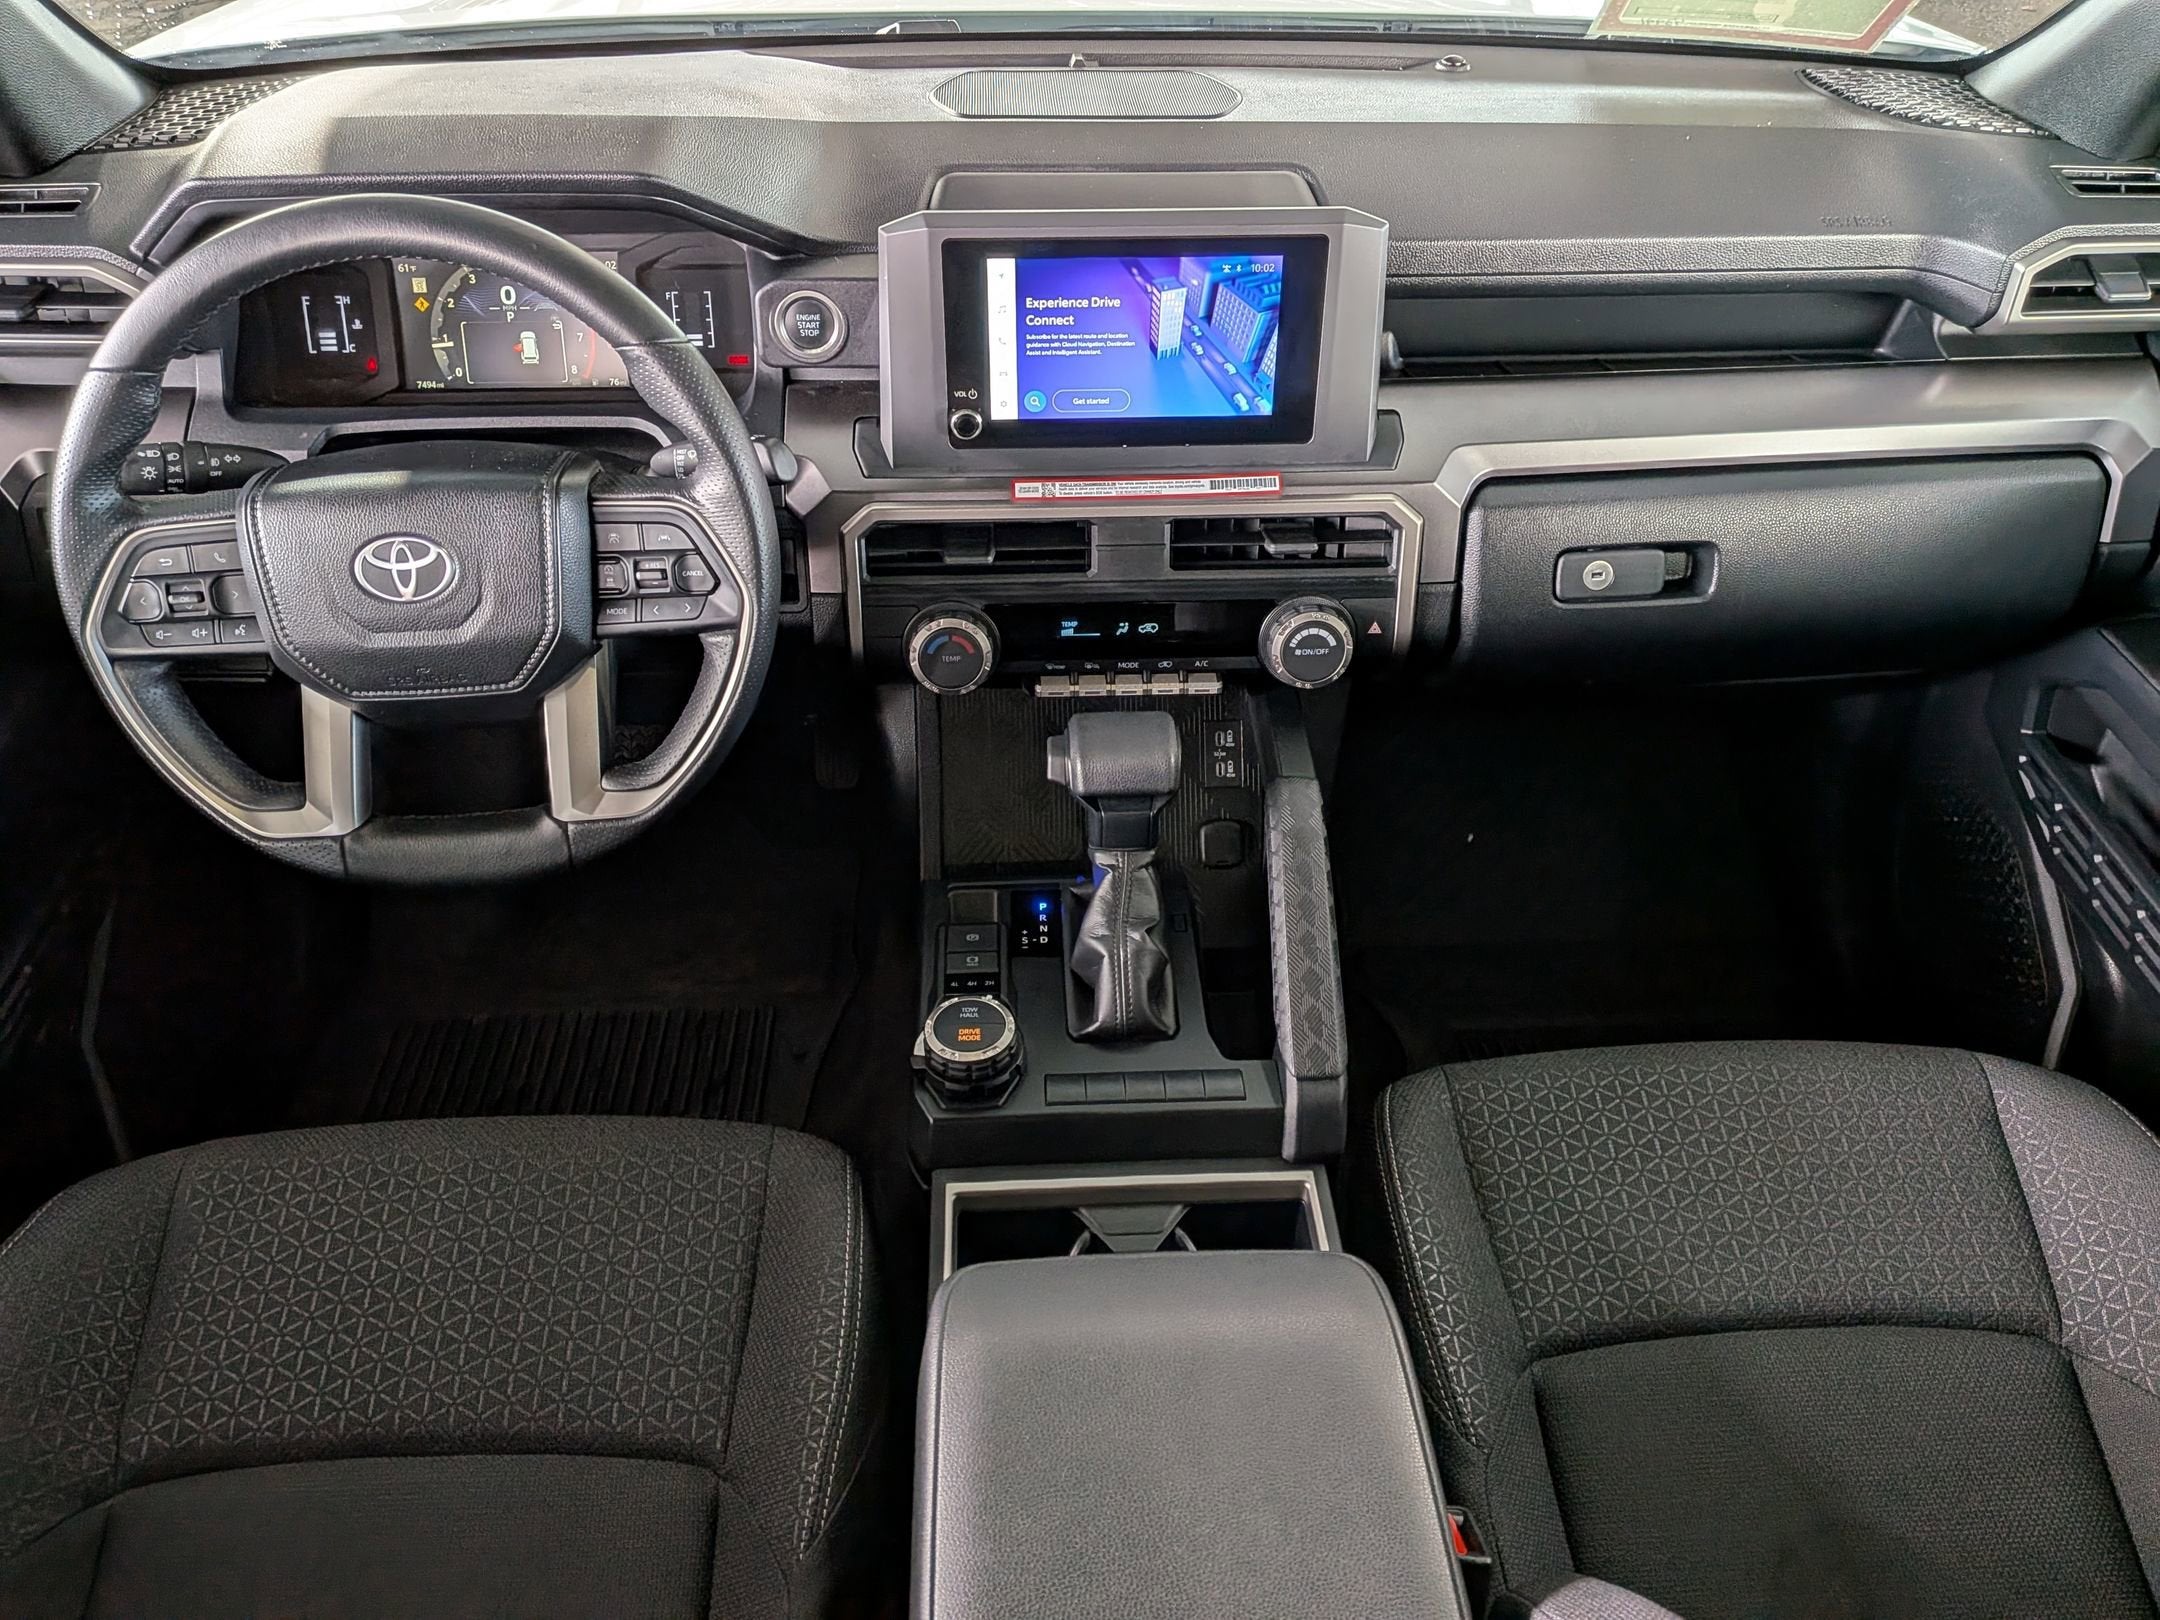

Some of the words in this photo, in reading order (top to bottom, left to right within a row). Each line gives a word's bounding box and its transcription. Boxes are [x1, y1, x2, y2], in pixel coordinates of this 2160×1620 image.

[1251, 263, 1275, 273] 10:02
[468, 273, 476, 284] 3
[500, 285, 516, 305] 0
[447, 297, 455, 308] 2
[1025, 296, 1089, 311] Experience
[1091, 296, 1121, 308] Drive
[506, 311, 514, 323] P
[796, 313, 821, 321] ENGINE
[1025, 315, 1075, 326] Connect
[797, 321, 820, 329] START
[576, 332, 584, 342] 7
[800, 329, 820, 337] STOP
[455, 367, 463, 377] 0
[570, 365, 578, 375] 8
[953, 390, 967, 398] VOL
[1072, 397, 1085, 405] Get
[1086, 396, 1110, 405] started
[606, 607, 628, 615] MODE
[1301, 648, 1330, 656] ON/OFF
[941, 655, 961, 663] TEMP
[1039, 902, 1048, 911] P
[1021, 936, 1029, 944] S
[1039, 936, 1049, 944] D
